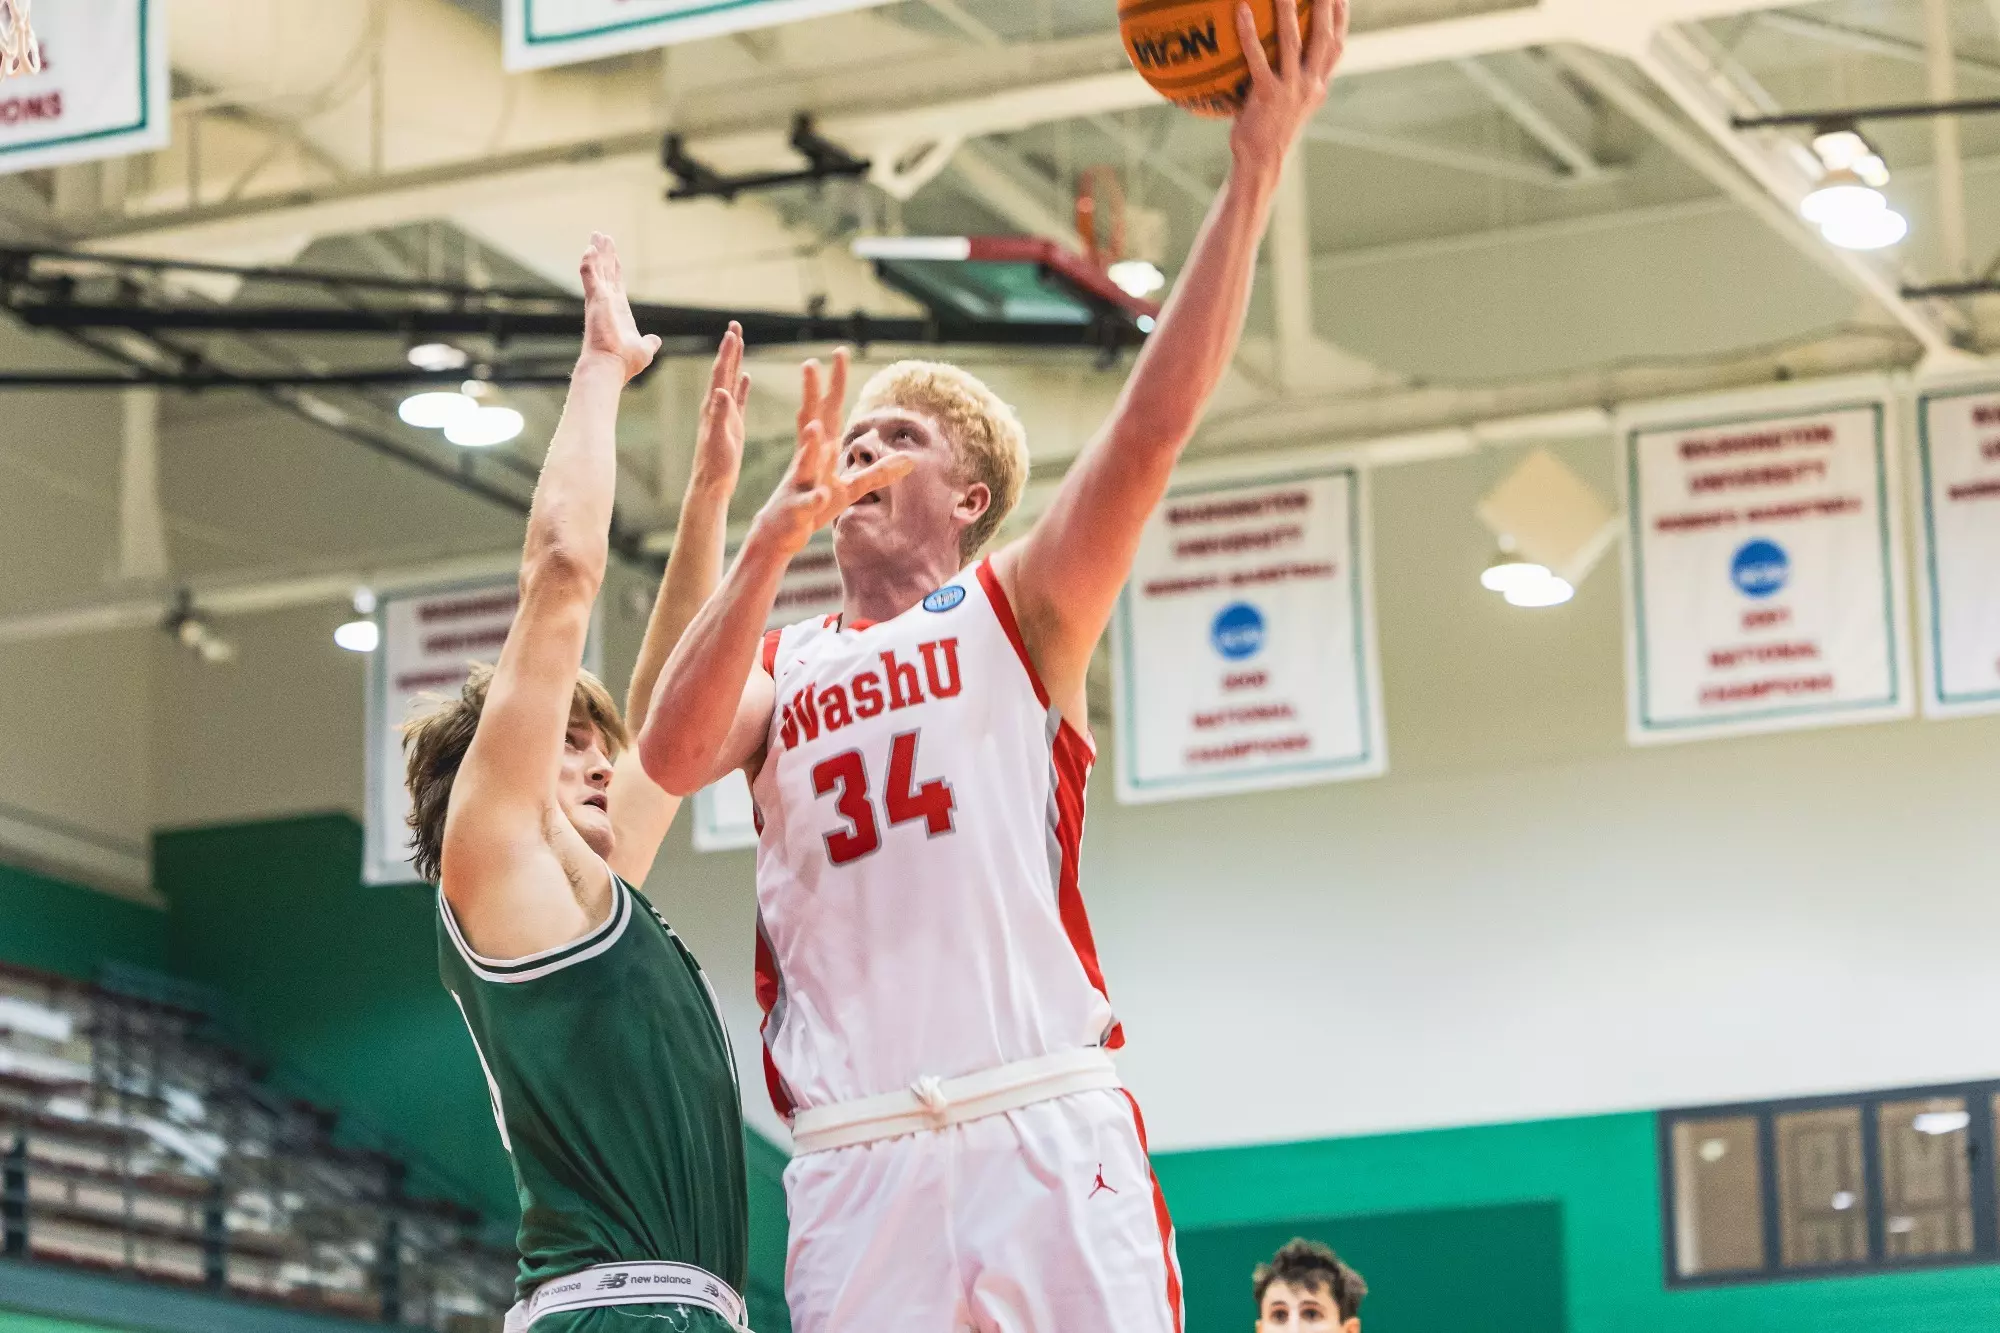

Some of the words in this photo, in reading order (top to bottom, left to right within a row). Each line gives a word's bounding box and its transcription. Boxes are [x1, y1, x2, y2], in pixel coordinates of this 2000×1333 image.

[779, 637, 962, 751] WashU
[809, 726, 958, 867] 34
[630, 1275, 652, 1284] new
[653, 1274, 692, 1285] balance
